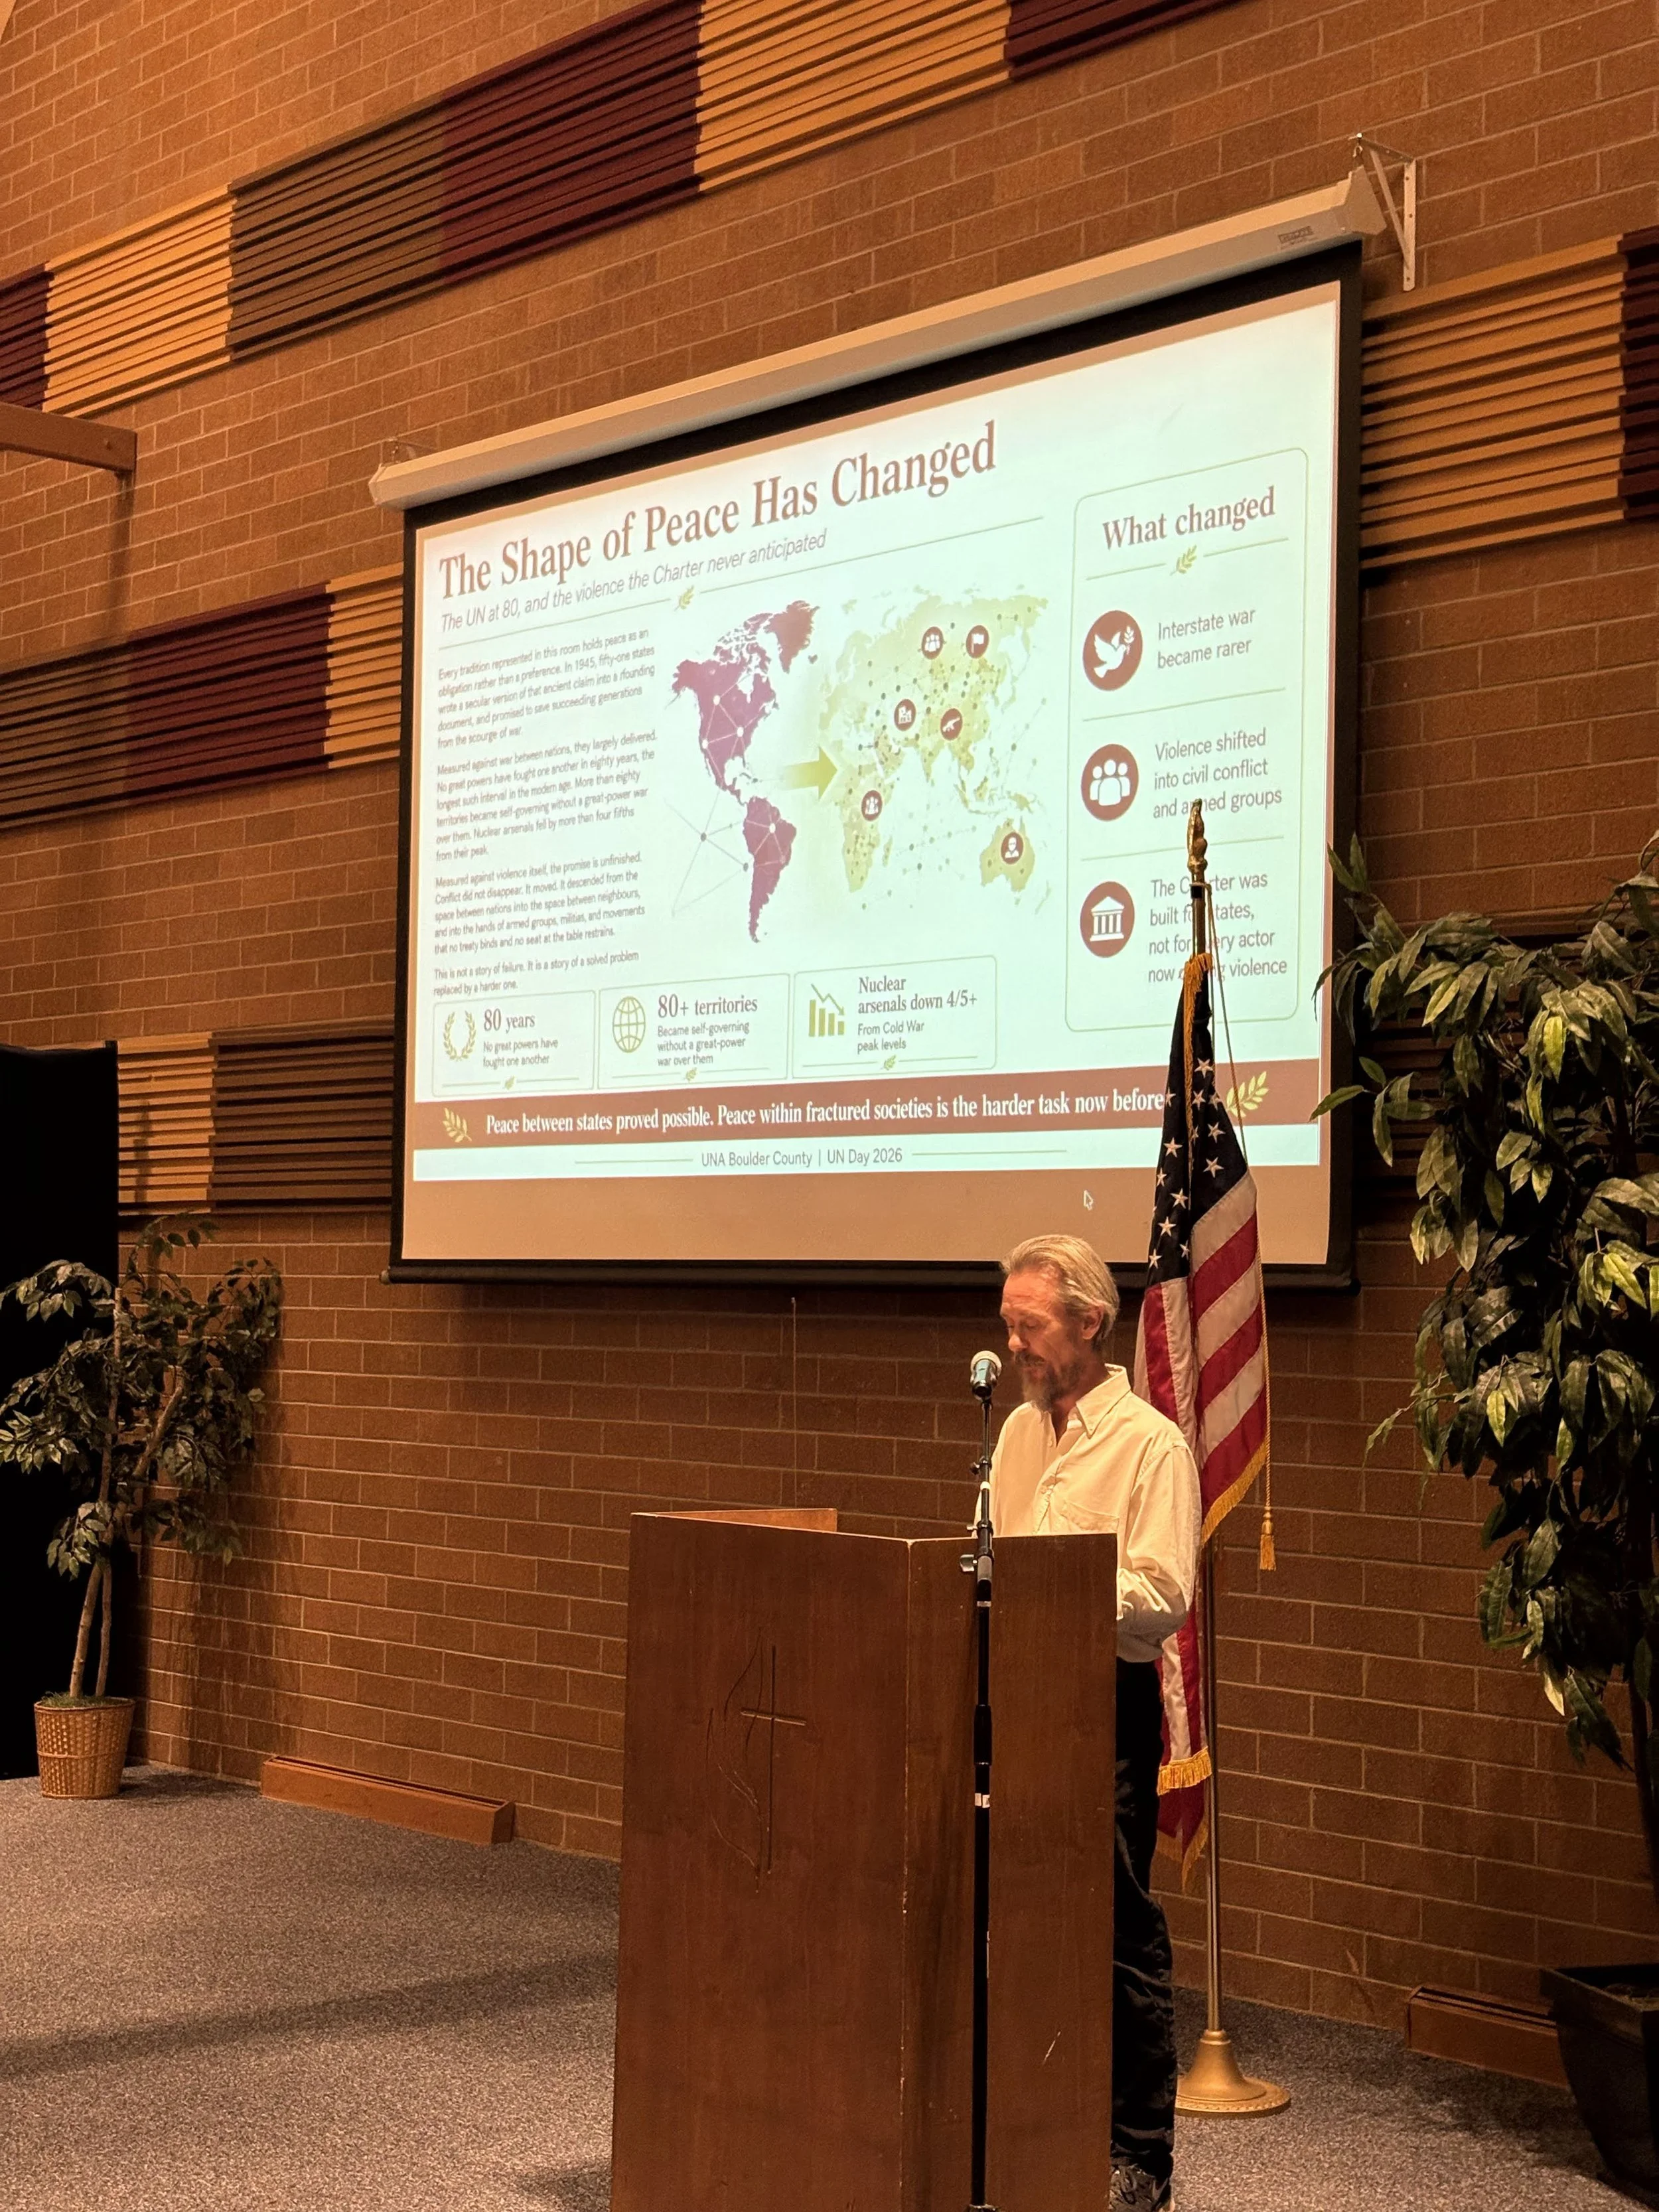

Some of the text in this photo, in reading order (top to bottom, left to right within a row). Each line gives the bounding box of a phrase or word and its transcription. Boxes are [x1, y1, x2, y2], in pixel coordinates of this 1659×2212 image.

[439, 419, 995, 599] The Shape of Peace Has Changed
[1102, 484, 1275, 550] What changed
[441, 528, 827, 632] The UN at 80, and the violence the Charter never anticipated
[1158, 609, 1255, 640] Interstate war
[1157, 639, 1252, 668] became rarer
[437, 686, 642, 732] document, and promised to save succeeding generations
[437, 729, 658, 776] Measured against war between nations, they largely delivered.
[1155, 727, 1265, 761] Violence shifted
[1154, 758, 1267, 790] into civil conflict
[1153, 789, 1282, 818] and aed groups
[435, 806, 634, 845] over them. Nuclear arsenals fell by more than four fifths
[435, 844, 488, 861] from their peak.
[435, 850, 641, 888] Measured against violence itself, the promise is unfinished.
[435, 869, 638, 905] Conflict did not disappear. It moved. It descended from the
[1151, 878, 1175, 897] The
[1239, 873, 1267, 889] was
[435, 889, 640, 924] space between nations into the space between neighbours,
[1150, 907, 1179, 926] built
[1214, 901, 1254, 921] tates,
[1149, 936, 1169, 956] not
[1174, 934, 1191, 953] for
[1238, 930, 1275, 948] actor
[1149, 968, 1175, 983] now
[1229, 957, 1287, 978] violence
[859, 975, 906, 994] Nuclear
[658, 994, 757, 1018] 80+ territories
[857, 989, 977, 1013] arsenals down 4/5+
[483, 1007, 534, 1033] 80 years
[657, 1020, 749, 1037] Became self-governing
[857, 1019, 924, 1035] From Cold War
[483, 1037, 558, 1053] No great powers have
[657, 1038, 745, 1052] without a great-power
[857, 1036, 906, 1054] peak levels
[482, 1053, 549, 1069] fought one another
[657, 1053, 713, 1066] war over them
[486, 1083, 1163, 1134] Peace between states proved possible. Peace within fractured societies is the harder task now before
[701, 1152, 725, 1167] UNA
[729, 1151, 770, 1166] Boulder
[772, 1150, 812, 1167] County
[827, 1149, 844, 1163] UN
[848, 1148, 869, 1166] Day
[873, 1147, 902, 1163] 2026
